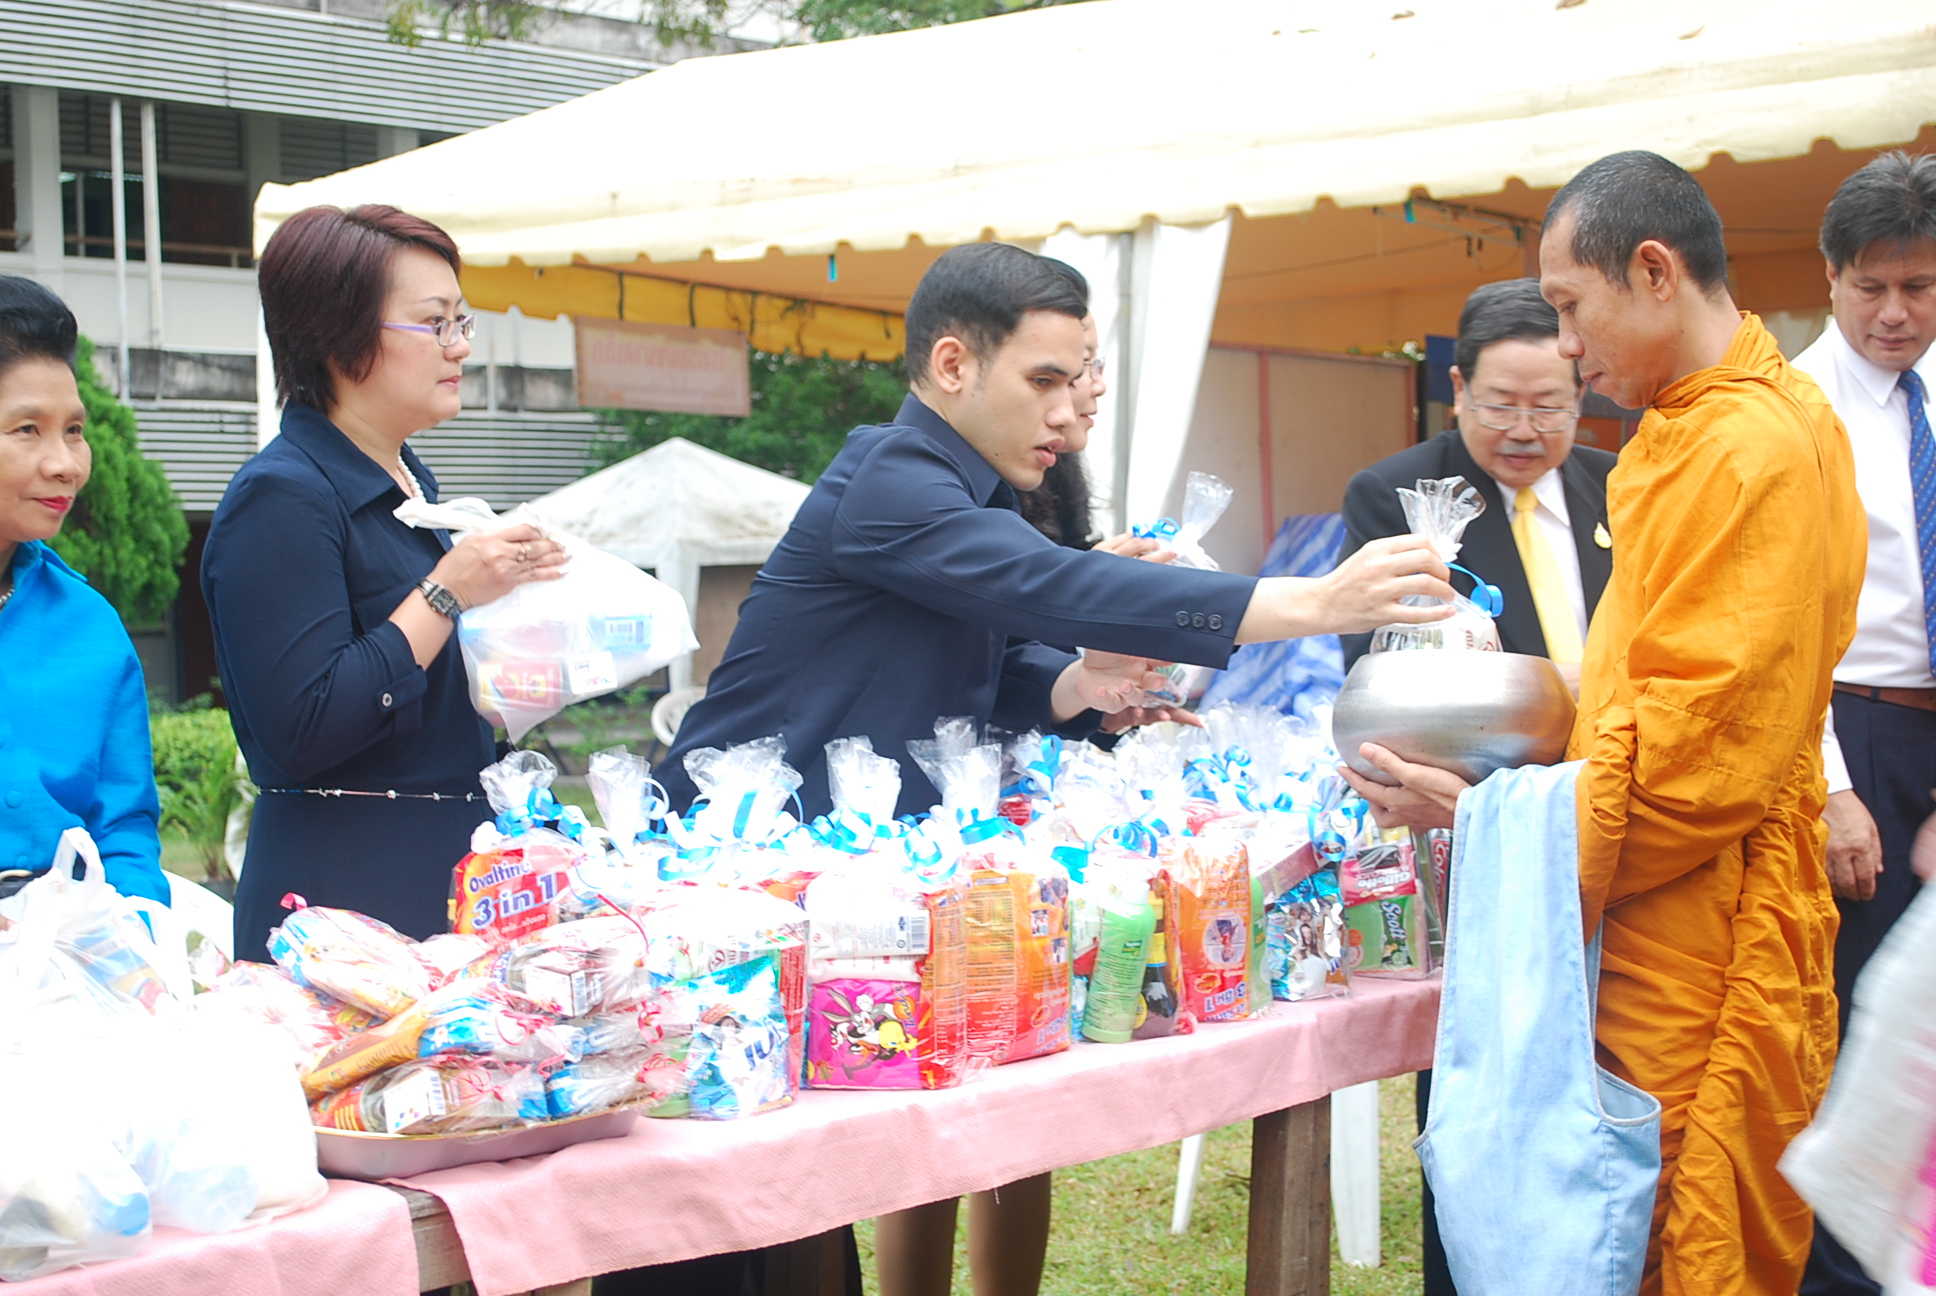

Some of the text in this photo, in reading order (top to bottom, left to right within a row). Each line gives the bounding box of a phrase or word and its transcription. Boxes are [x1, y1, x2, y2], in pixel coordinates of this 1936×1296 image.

[469, 860, 533, 893] Ovaltine
[1357, 871, 1411, 889] Gillette
[471, 896, 496, 929] 3
[499, 889, 535, 919] in
[536, 871, 557, 903] 1
[1381, 900, 1407, 941] Scott
